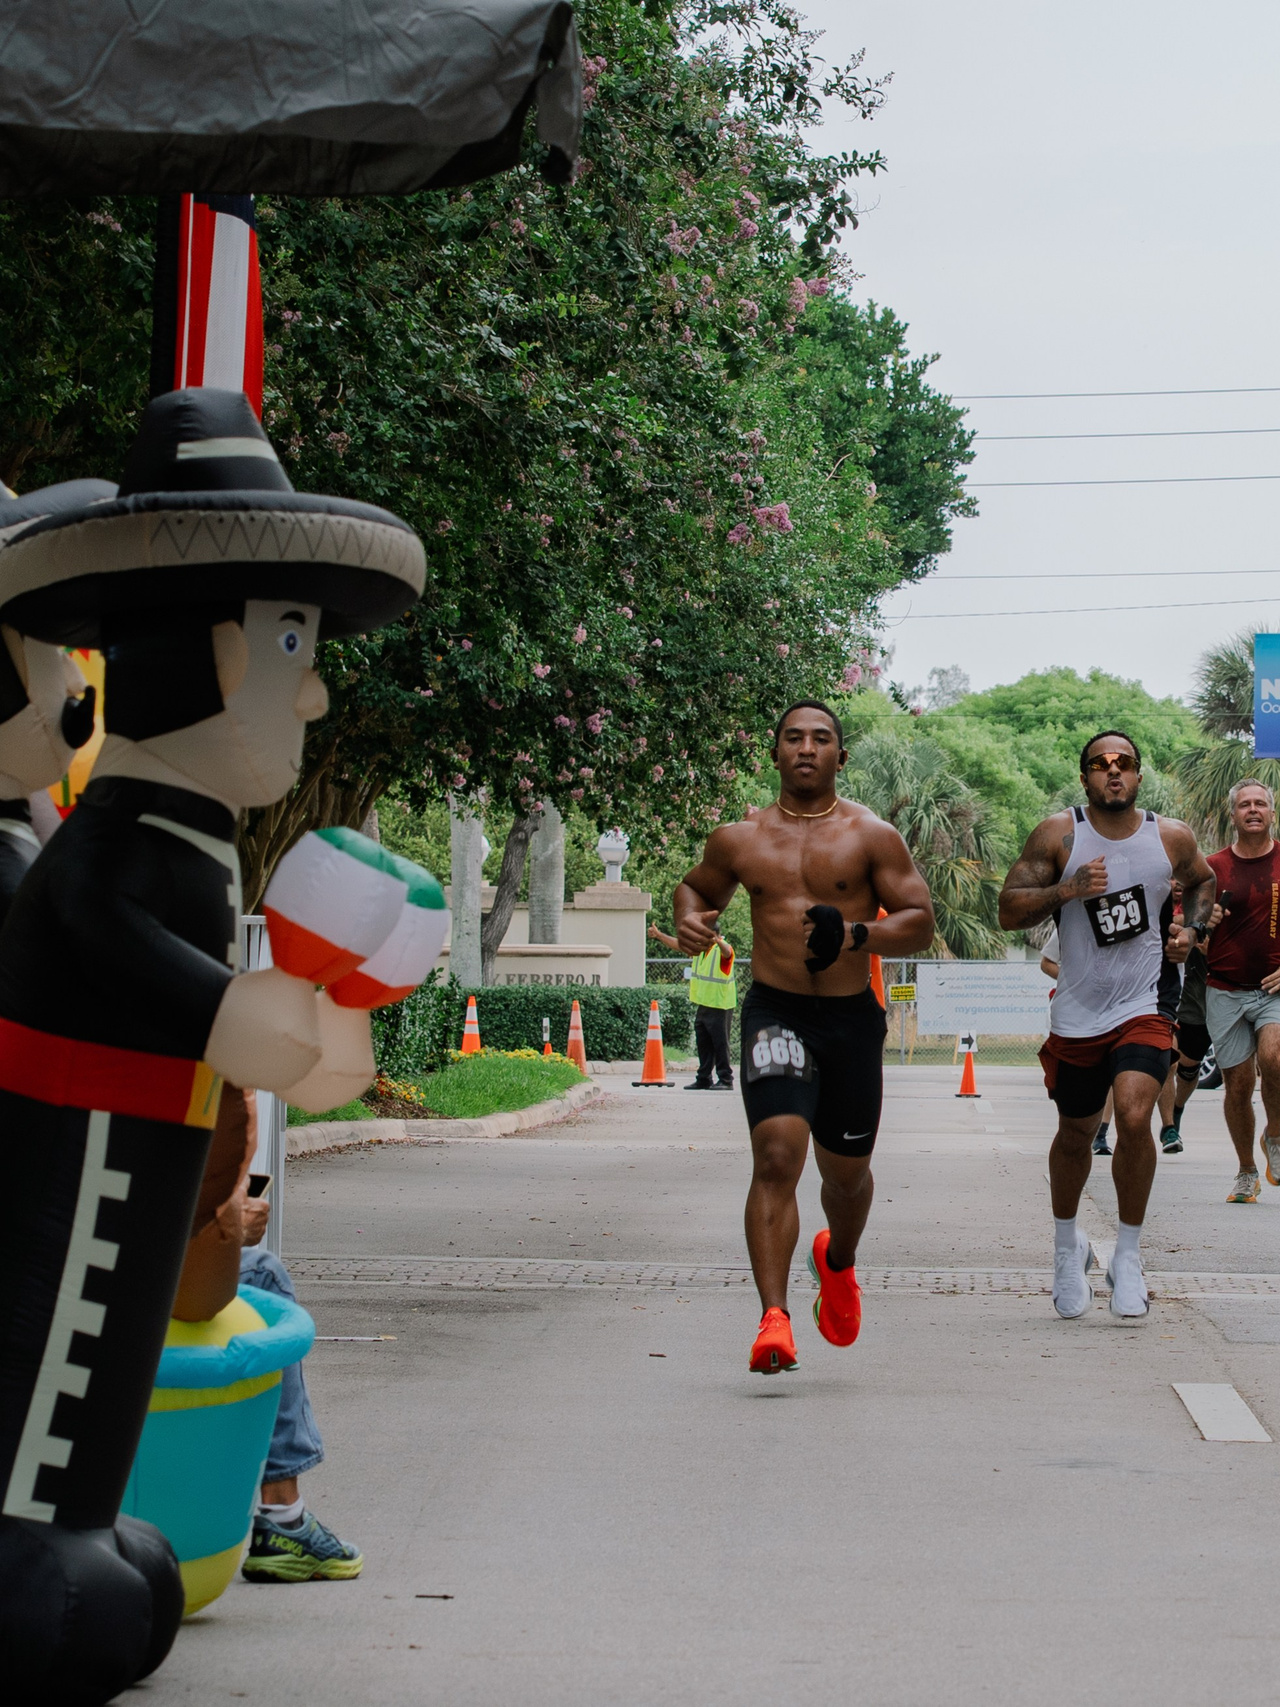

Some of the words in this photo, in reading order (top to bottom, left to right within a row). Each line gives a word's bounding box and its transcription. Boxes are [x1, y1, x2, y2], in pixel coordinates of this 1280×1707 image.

[1119, 891, 1133, 902] 5K
[1269, 882, 1279, 939] ELEMENTARY
[1096, 899, 1142, 935] 529
[752, 1036, 806, 1069] 669
[267, 1533, 303, 1557] HOKA
